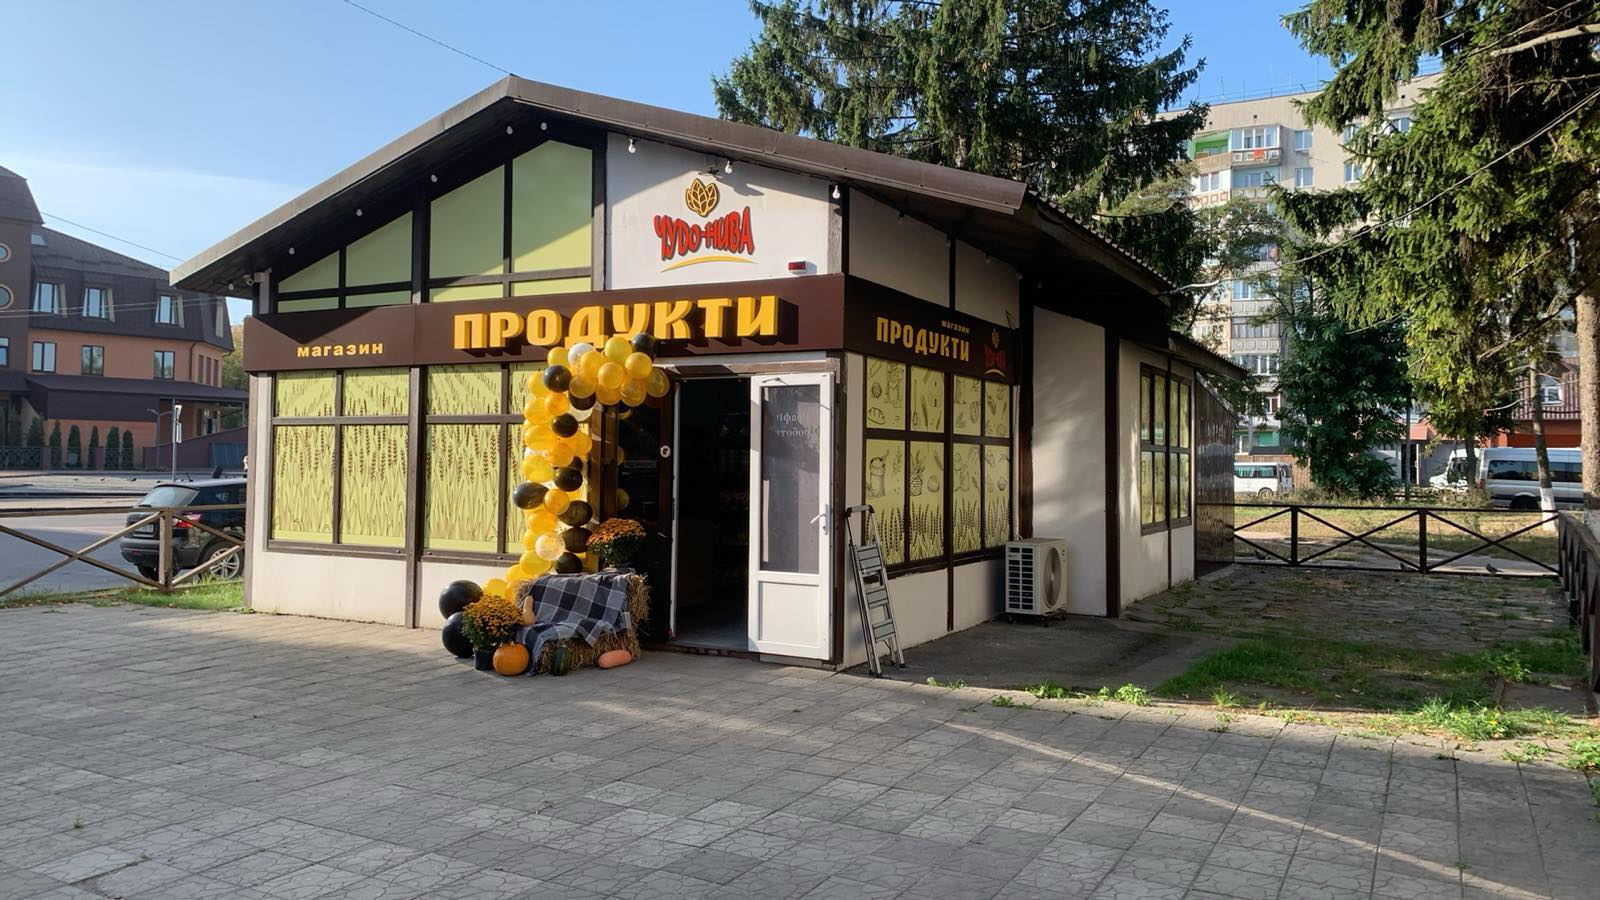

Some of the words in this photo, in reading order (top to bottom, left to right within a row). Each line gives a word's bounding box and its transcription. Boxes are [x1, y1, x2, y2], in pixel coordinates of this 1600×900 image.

[453, 295, 779, 350] ПРОДУКТИ
[876, 316, 970, 362] ПРОДУКТИ
[297, 342, 384, 358] магазин
